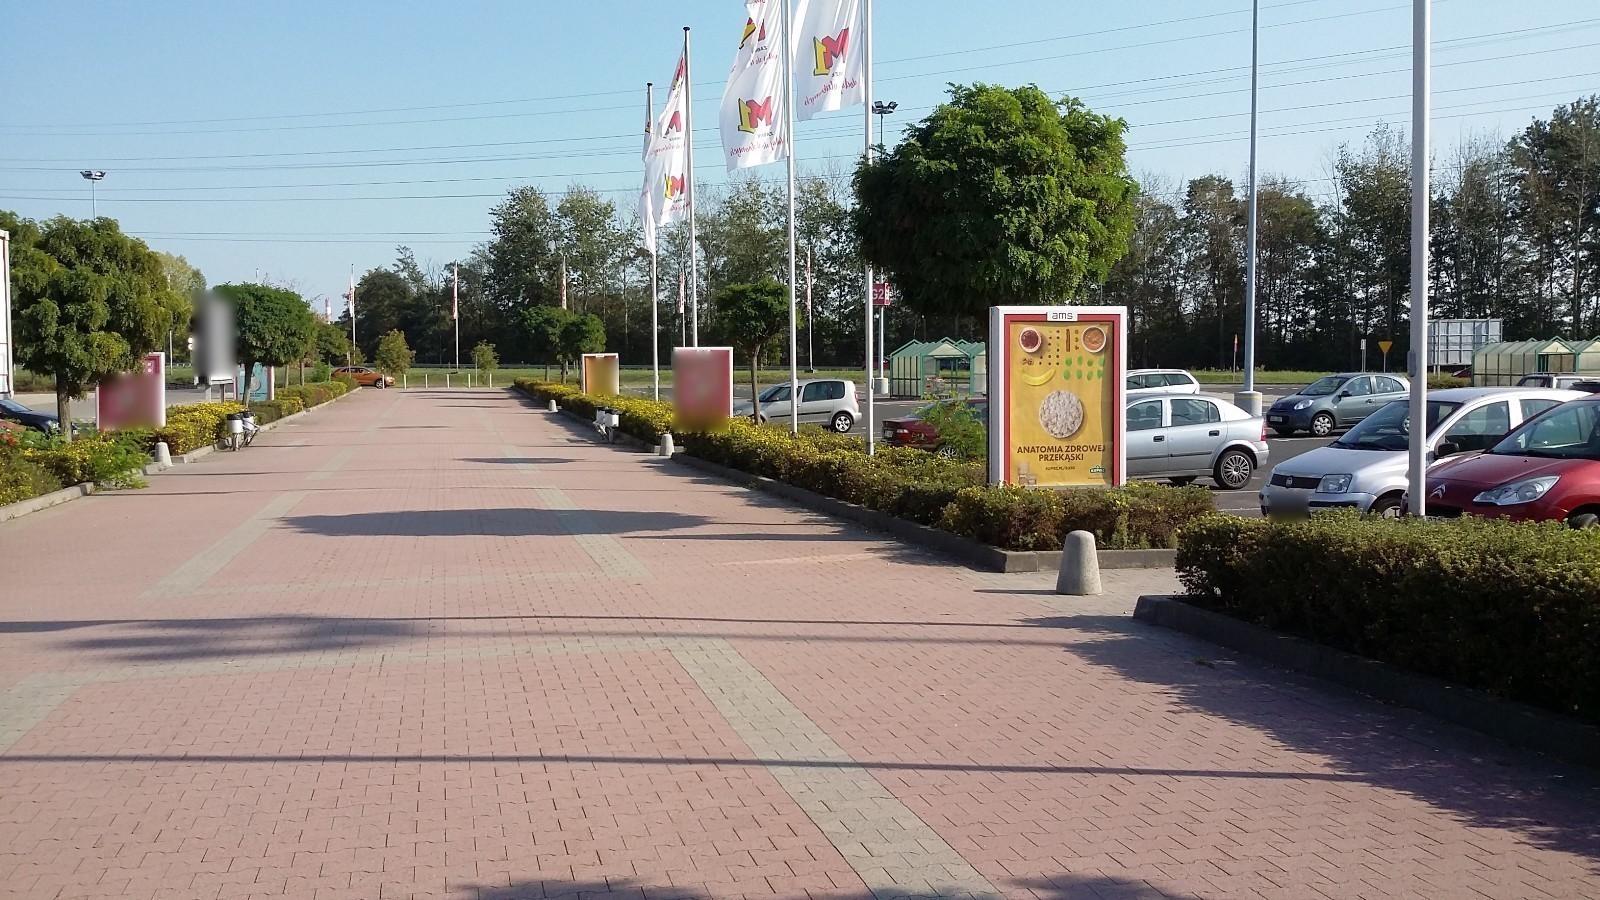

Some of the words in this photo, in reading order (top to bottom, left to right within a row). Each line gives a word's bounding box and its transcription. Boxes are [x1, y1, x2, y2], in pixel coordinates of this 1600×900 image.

[1017, 445, 1063, 453] ANATOMIA
[1064, 445, 1106, 453] ZDROWEJ
[1038, 453, 1084, 462] PRZEKĄSKI
